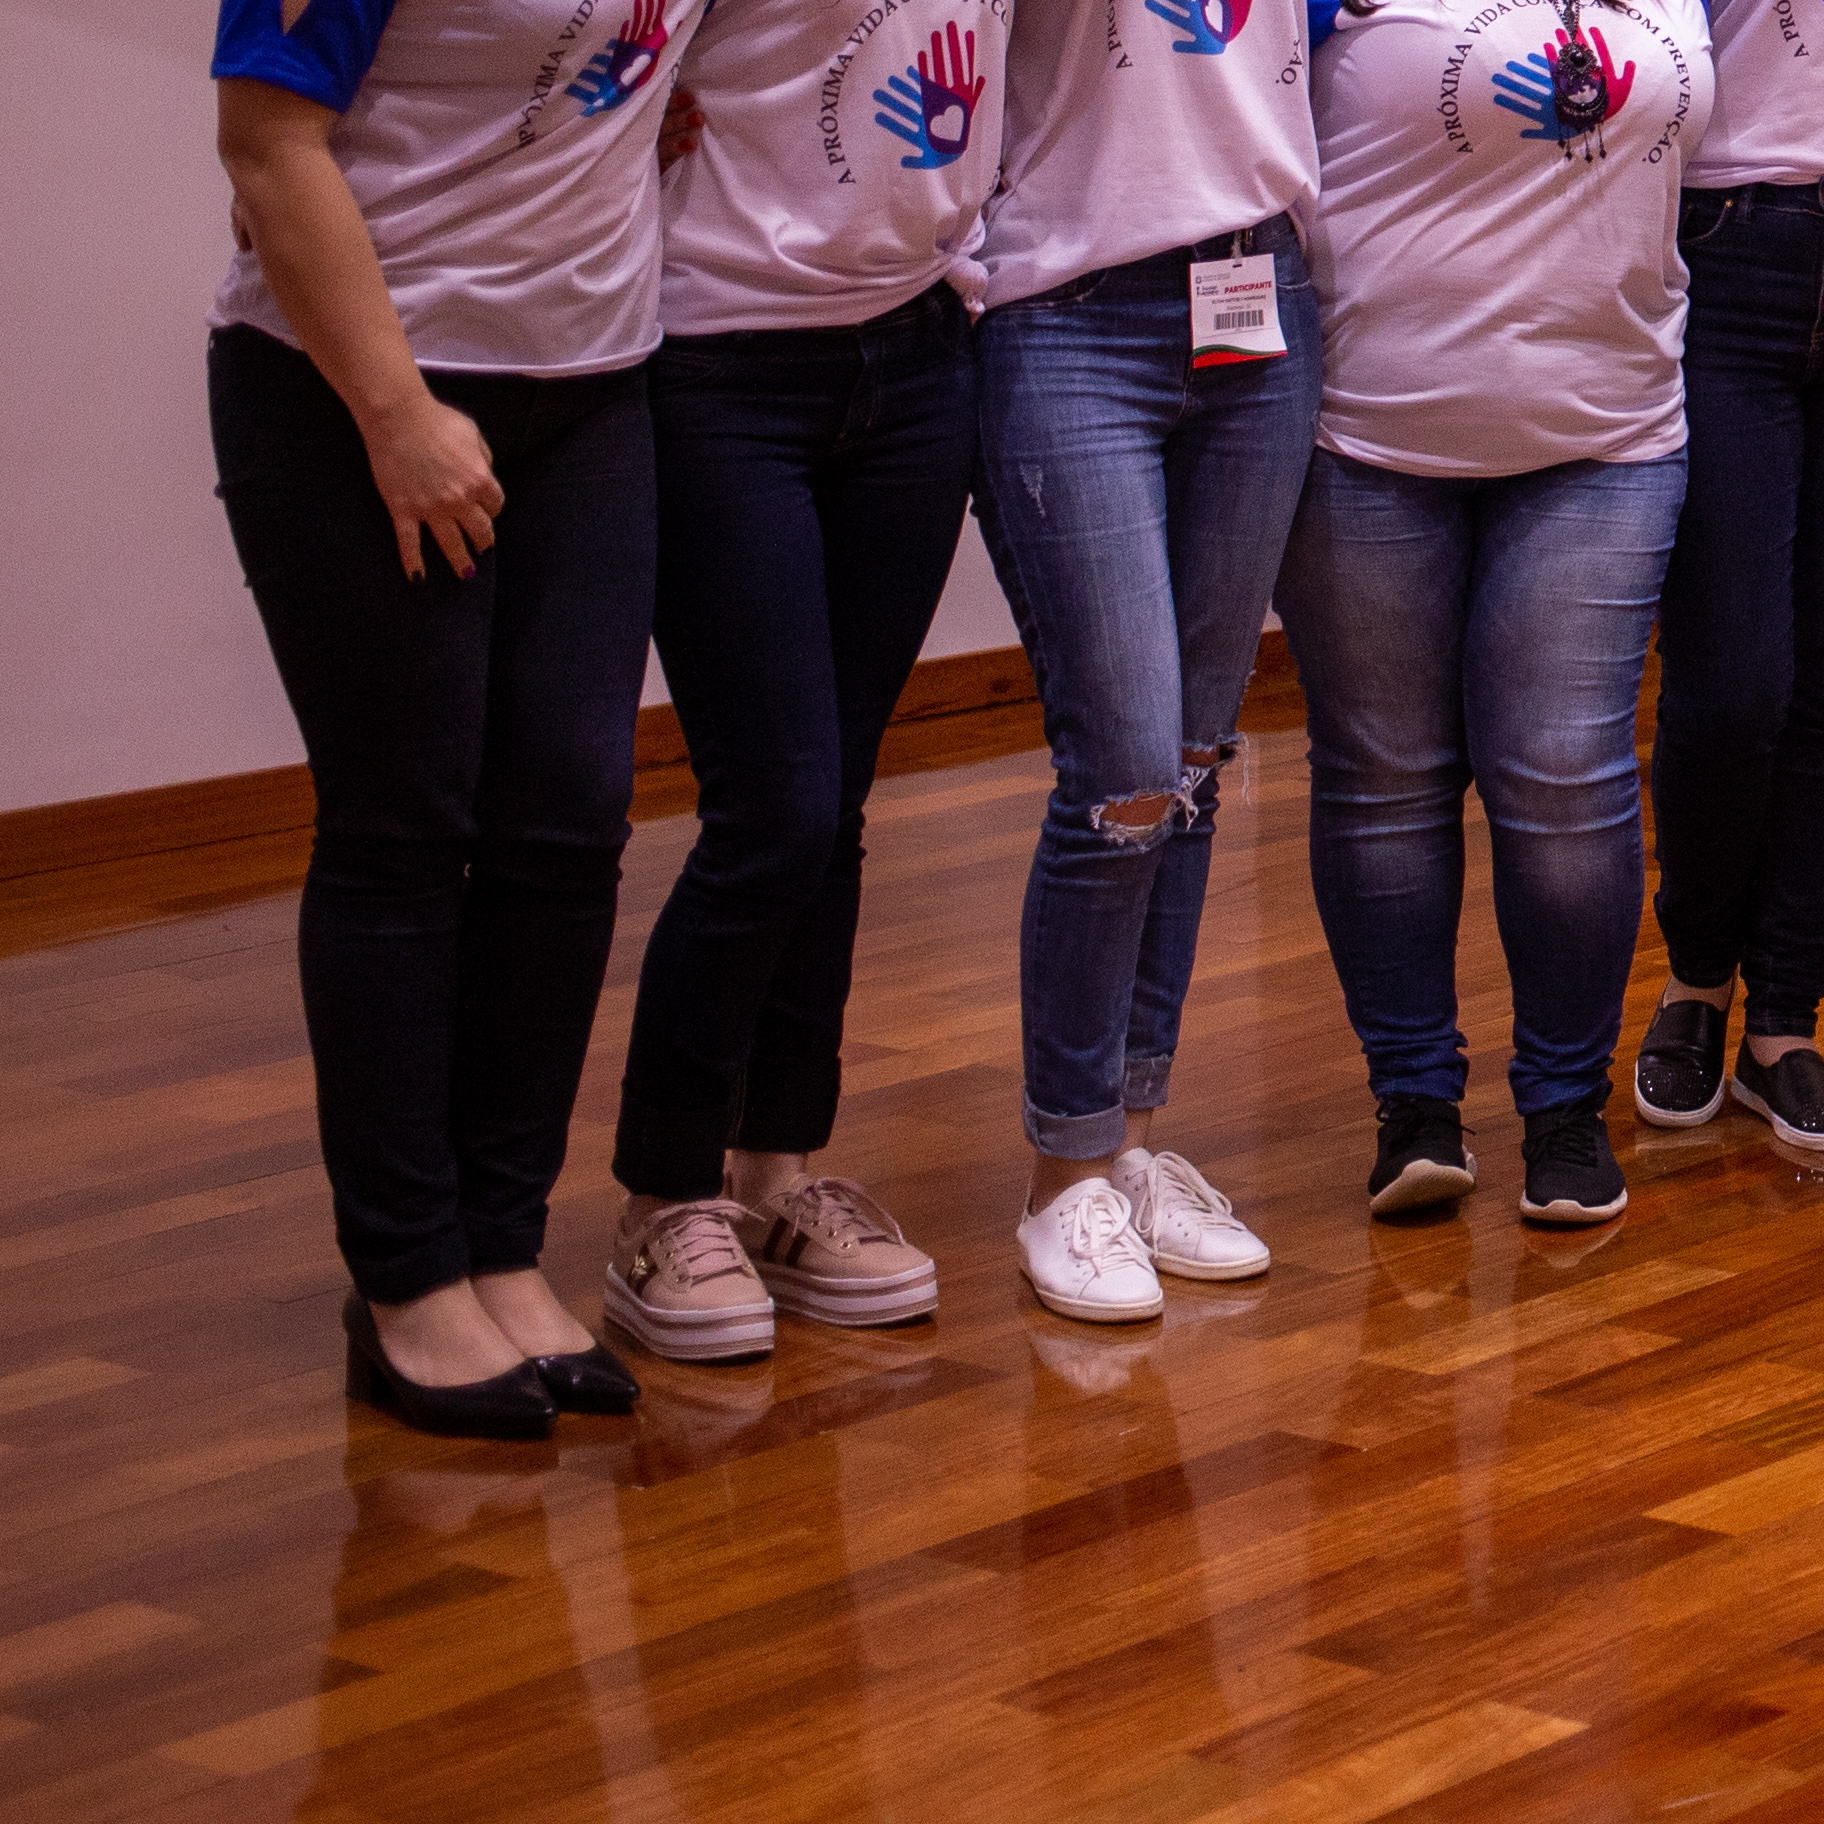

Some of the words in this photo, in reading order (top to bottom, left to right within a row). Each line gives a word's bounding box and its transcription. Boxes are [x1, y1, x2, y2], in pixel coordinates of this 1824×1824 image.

[1464, 2, 1512, 37] VIDA
[1794, 43, 1810, 59] A
[1115, 53, 1134, 70] A
[1435, 42, 1473, 144] PRÓXIMA
[1642, 35, 1692, 165] PREVENÇÃO.
[816, 53, 854, 167] PRÓXIMA
[1455, 141, 1474, 155] A
[836, 168, 857, 186] A
[1223, 280, 1273, 294] PARTICIPANTE
